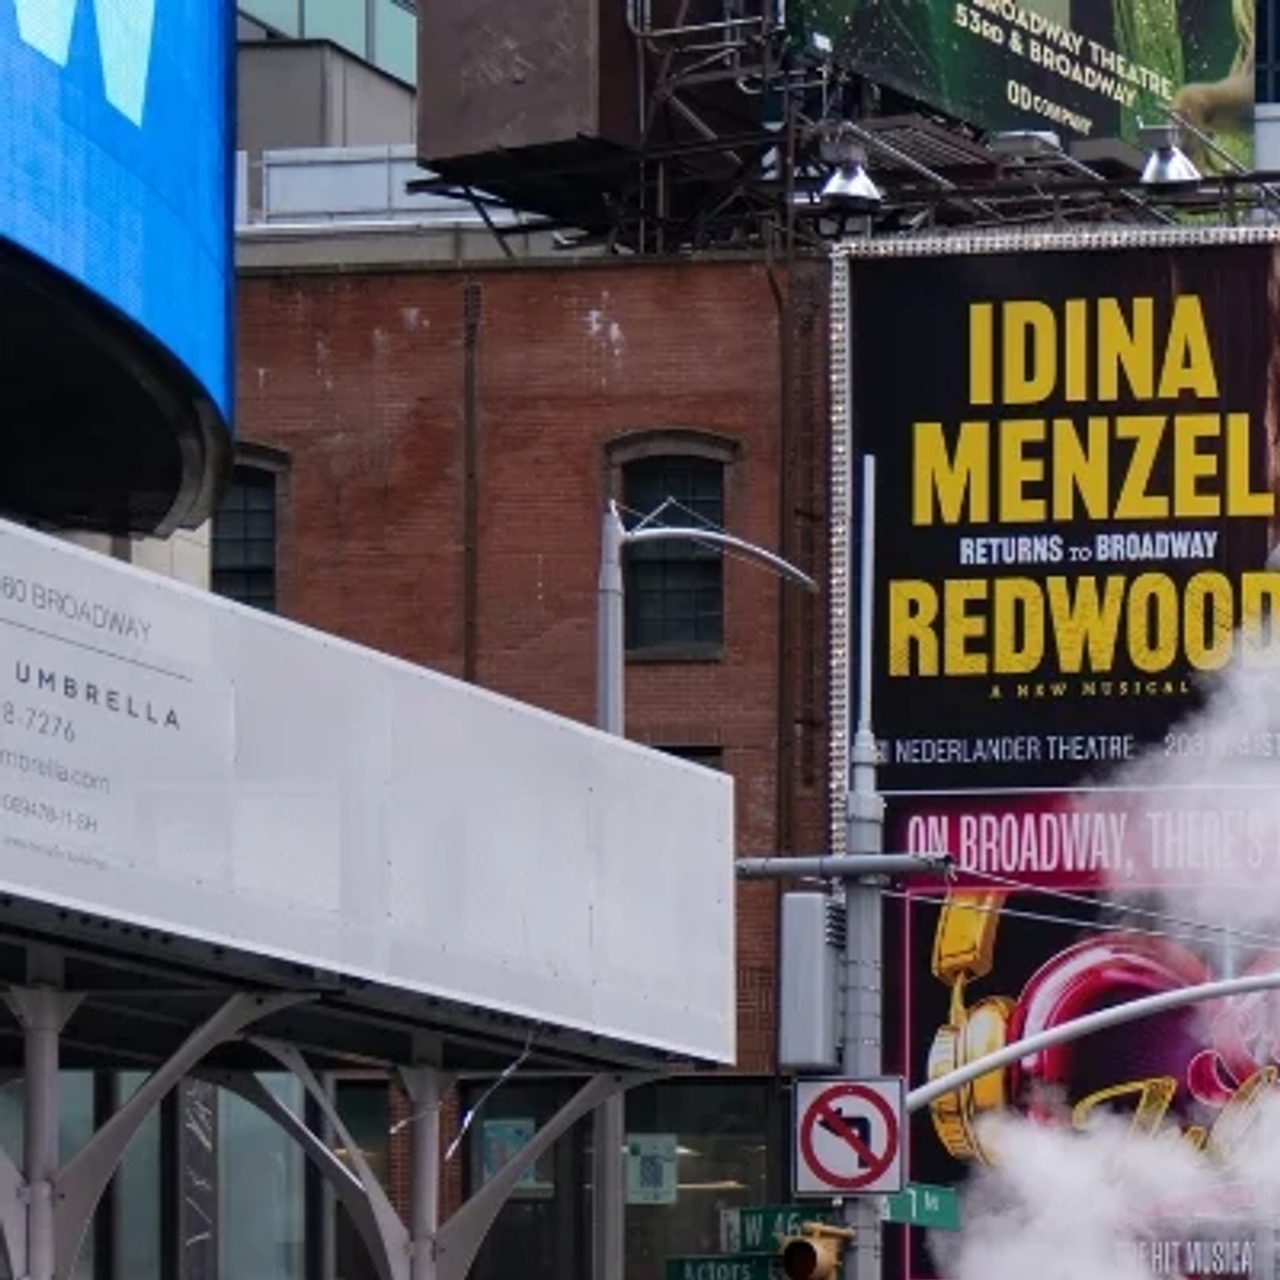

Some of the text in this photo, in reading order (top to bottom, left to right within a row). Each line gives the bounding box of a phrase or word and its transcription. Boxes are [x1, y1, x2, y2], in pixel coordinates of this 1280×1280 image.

[954, 4, 1137, 107] 53RD & BROADWAY
[1088, 41, 1173, 100] THEATRE
[969, 295, 1220, 405] IDINA
[912, 413, 1276, 526] MENZEL
[960, 535, 1064, 565] RETURNS
[1096, 531, 1218, 561] BROADWAY
[32, 583, 152, 642] BROADWAY
[16, 661, 180, 730] UMBRELLA
[1017, 684, 1067, 698] NEW
[1082, 681, 1190, 696] MUSICAL
[896, 737, 1041, 763] NEDERLANDER
[1047, 734, 1134, 760] THEATRE
[908, 815, 948, 858] ON
[959, 812, 1133, 877] BROADWAY,
[743, 1215, 764, 1246] W
[908, 1189, 918, 1219] 7
[1151, 1241, 1182, 1274] HIT
